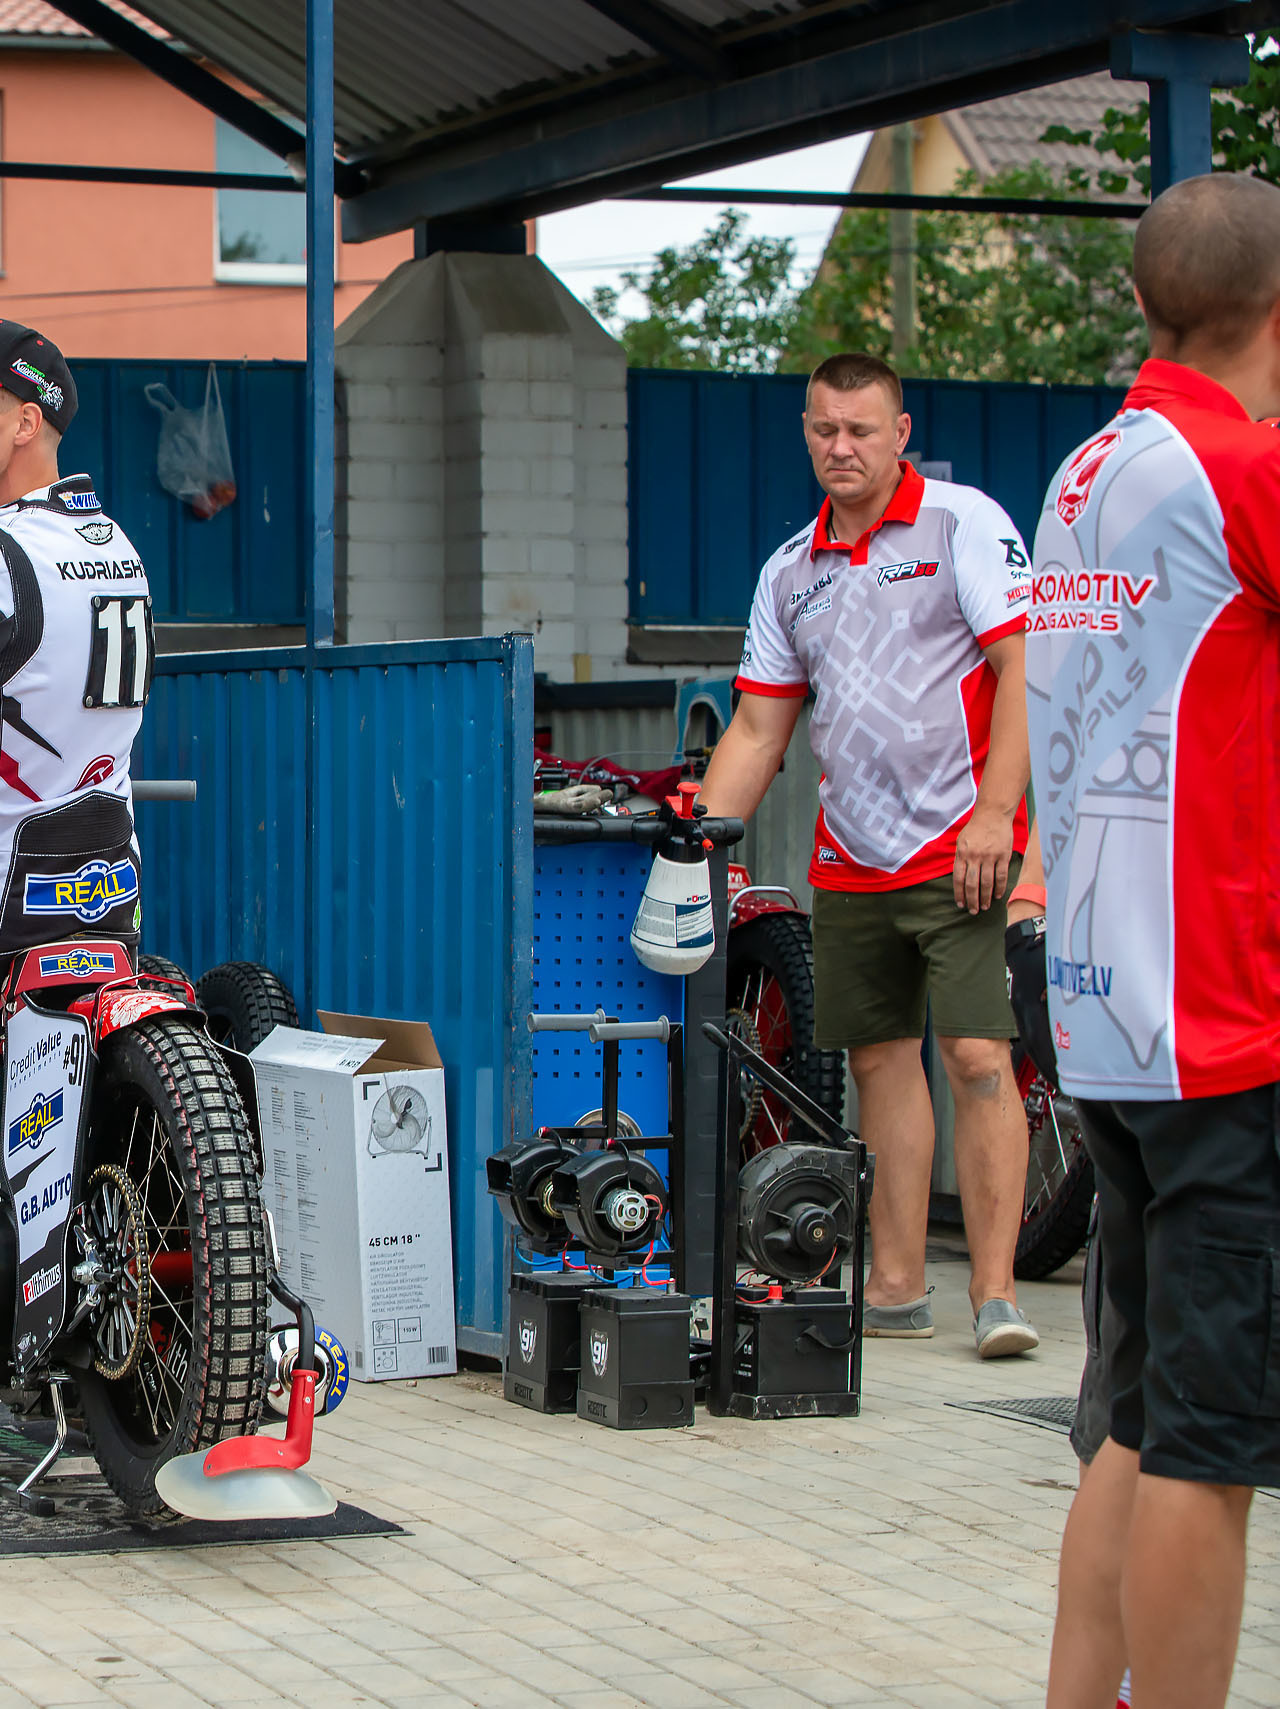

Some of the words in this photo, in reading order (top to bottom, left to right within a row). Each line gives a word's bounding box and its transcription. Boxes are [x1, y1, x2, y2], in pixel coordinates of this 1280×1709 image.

[97, 599, 147, 705] 11
[55, 873, 126, 905] REALL
[57, 955, 105, 971] REALL
[62, 1033, 87, 1087] #91
[19, 1101, 55, 1137] REALL
[20, 1194, 41, 1226] G.B.
[41, 1172, 72, 1208] AUTO
[369, 1237, 381, 1248] 45
[383, 1236, 398, 1246] CM
[401, 1234, 413, 1245] 18
[25, 1264, 62, 1301] althimus
[319, 1331, 346, 1398] REALL
